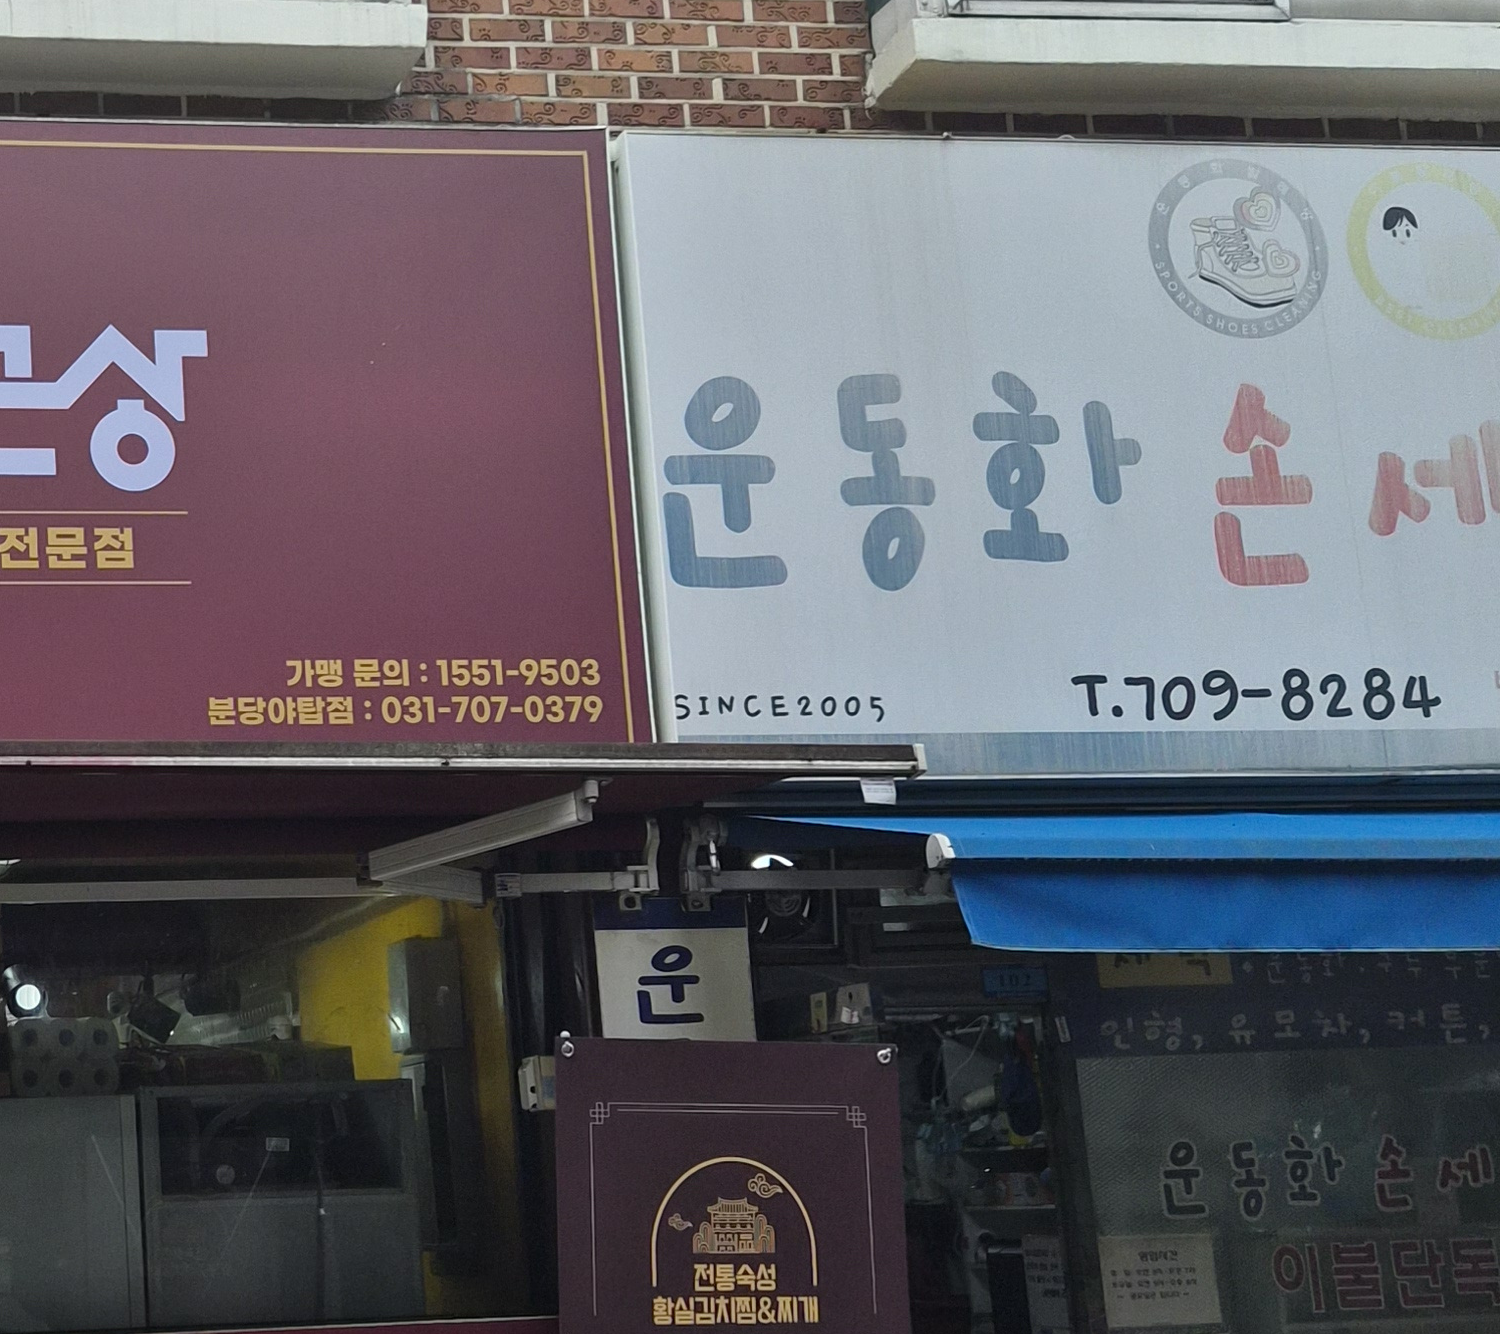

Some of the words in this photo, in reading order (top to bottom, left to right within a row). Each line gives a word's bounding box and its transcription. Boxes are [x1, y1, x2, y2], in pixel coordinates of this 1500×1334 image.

[1206, 314, 1258, 335] SHOES
[663, 371, 1143, 592] 운동화
[285, 659, 344, 688] 가맹
[353, 659, 411, 687] 문의
[437, 658, 601, 687] 1551-9503
[207, 697, 354, 725] 분당야탑점
[382, 695, 603, 724] 031-707-0379
[1070, 668, 1442, 722] T.709-8284
[636, 945, 705, 1025] 운
[1161, 1134, 1345, 1221] 운동화
[693, 1263, 777, 1292] 전통숙성
